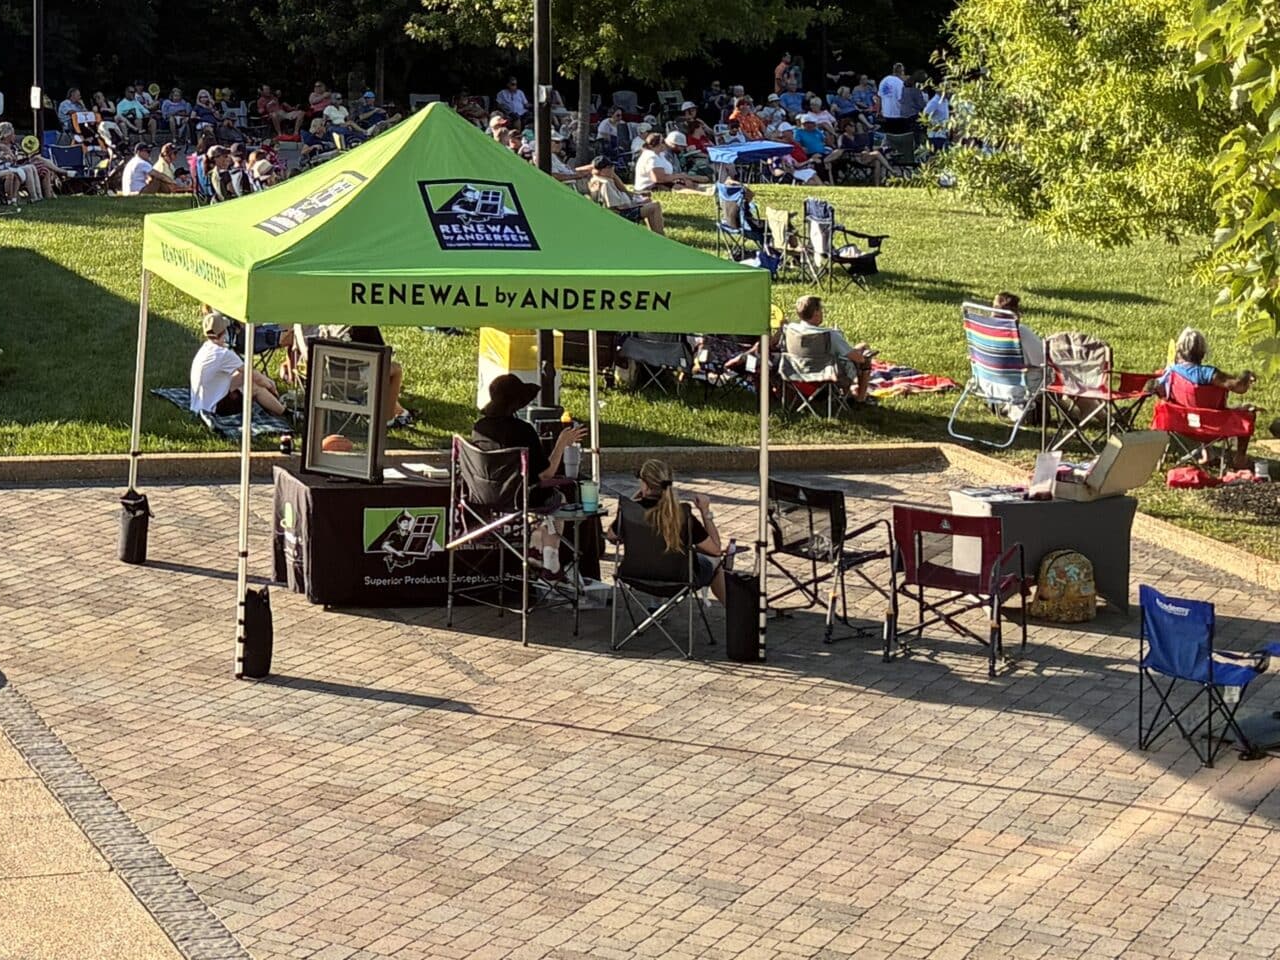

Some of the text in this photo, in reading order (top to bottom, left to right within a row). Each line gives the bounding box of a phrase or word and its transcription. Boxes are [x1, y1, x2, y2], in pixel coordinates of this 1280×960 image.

[440, 224, 526, 235] RENEWAL
[456, 233, 530, 242] ANDERSEN
[351, 282, 672, 311] RENEWAL by ANDERSEN
[364, 575, 403, 587] Superior
